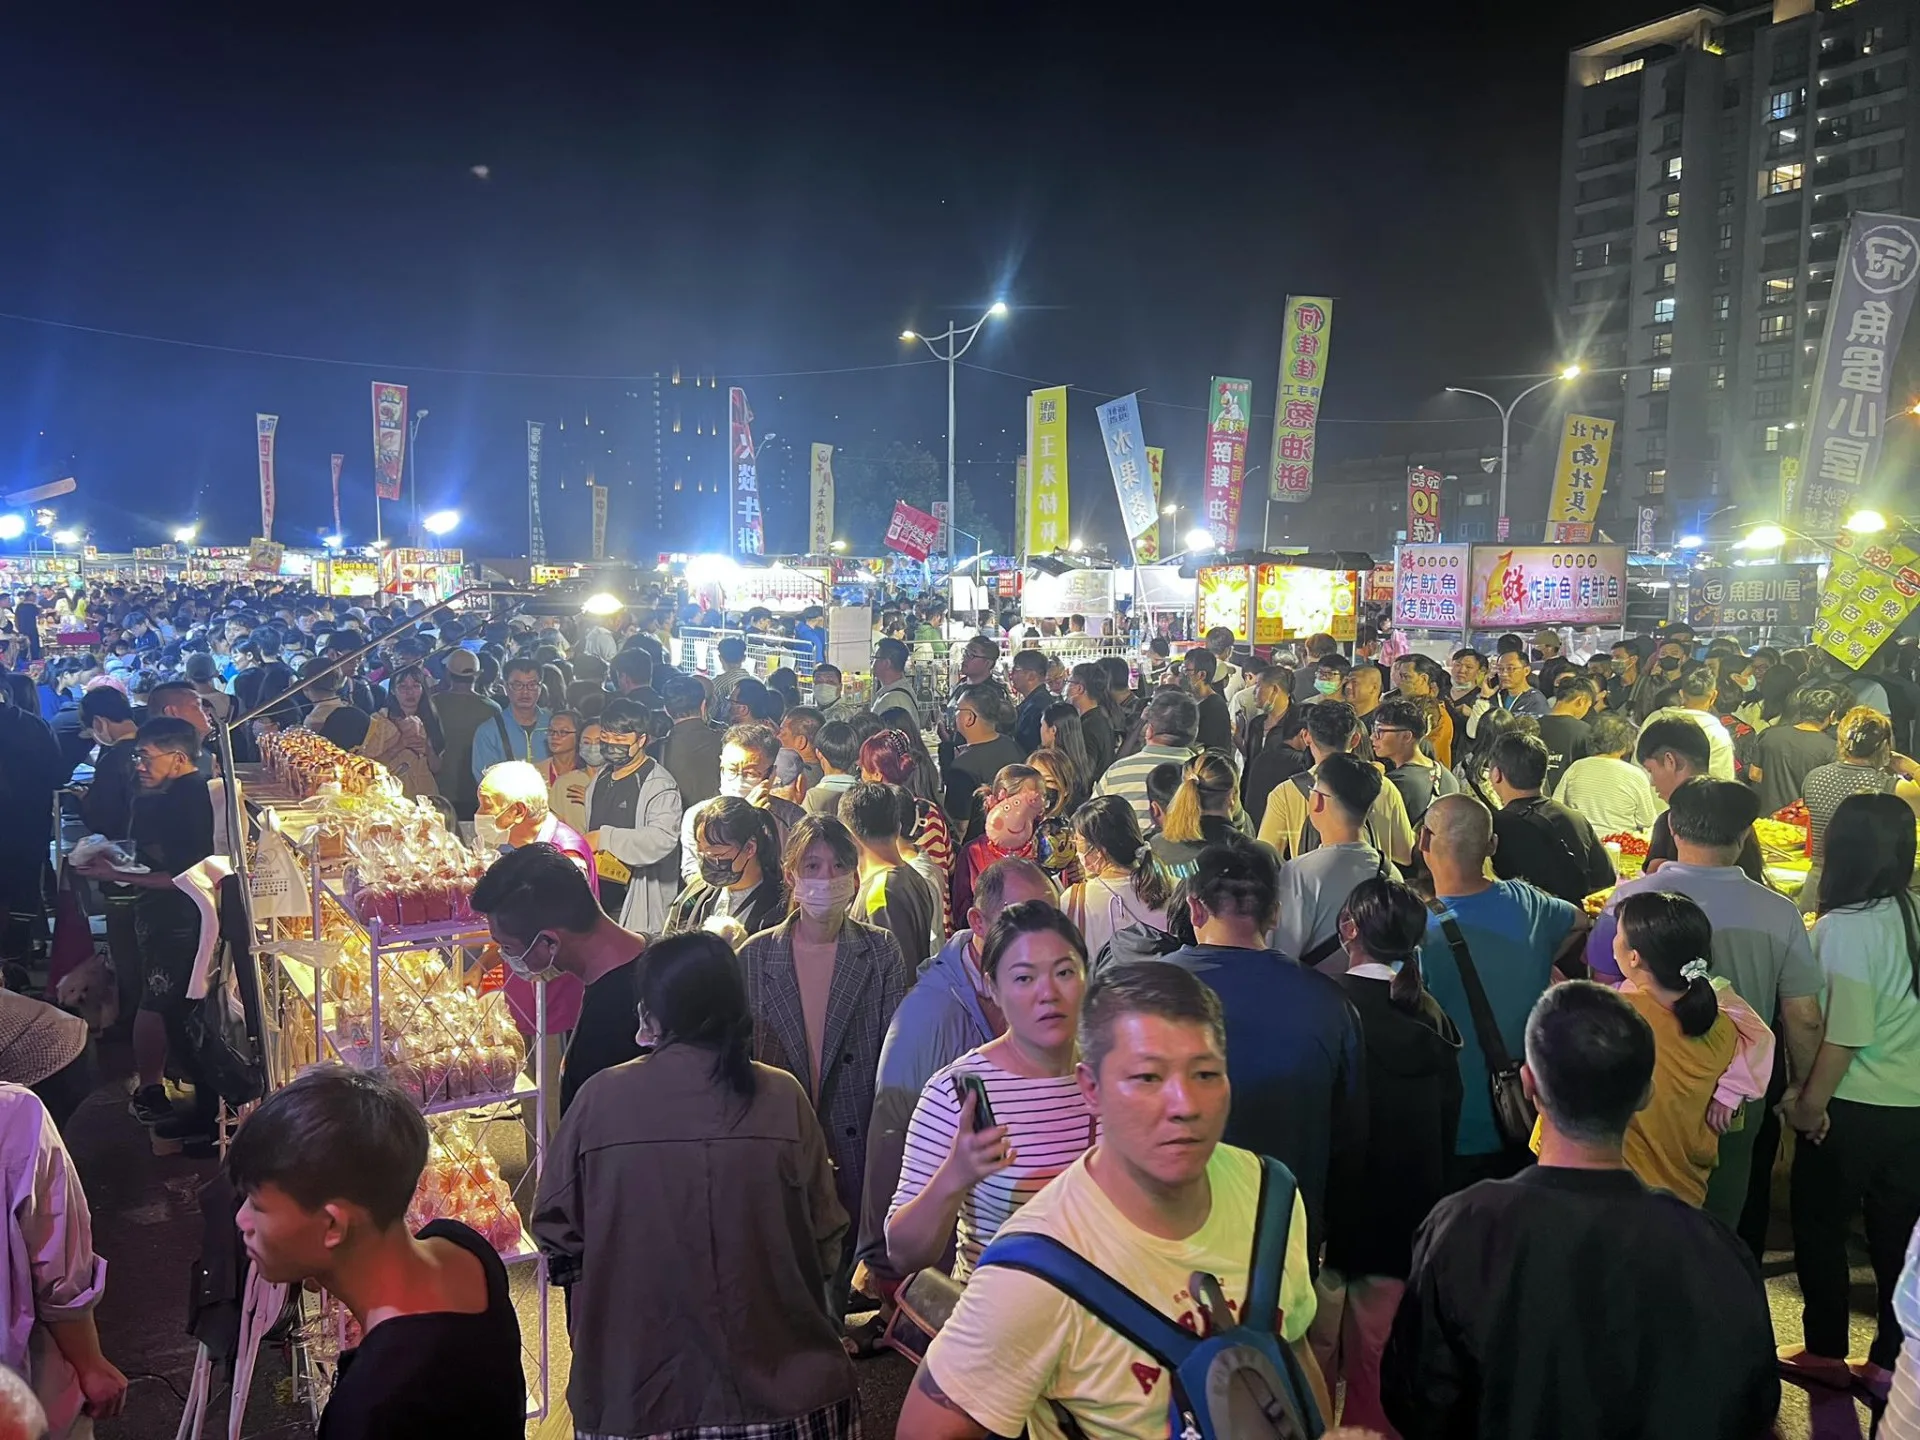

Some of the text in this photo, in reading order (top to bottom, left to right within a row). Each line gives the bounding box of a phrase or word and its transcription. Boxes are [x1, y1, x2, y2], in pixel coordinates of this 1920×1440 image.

[1401, 550, 1415, 571] 鮮
[1401, 573, 1457, 595] 炸魷魚
[1502, 564, 1619, 614] 鮮 炸魷魚 烤魷魚
[1729, 579, 1801, 602] 魚蛋小屋
[1400, 598, 1456, 620] 烤魷魚
